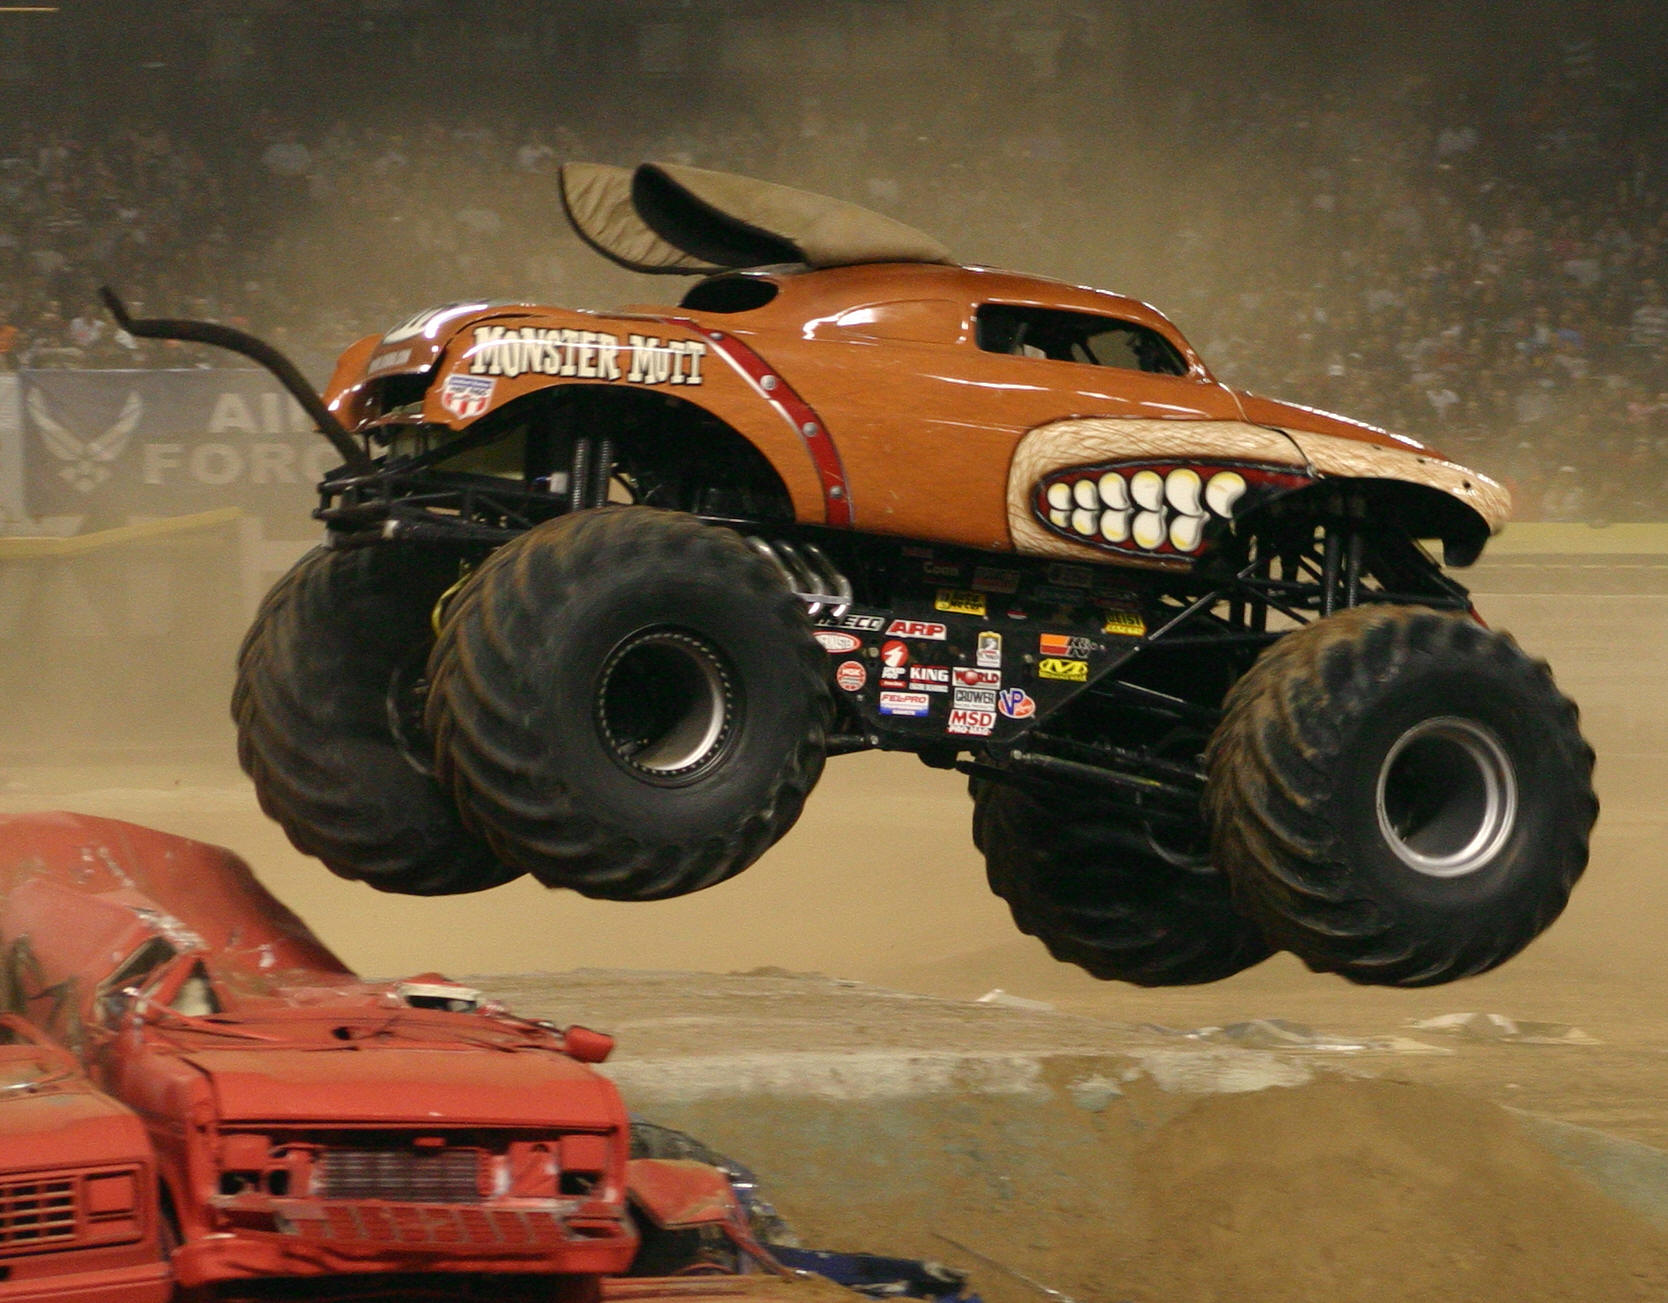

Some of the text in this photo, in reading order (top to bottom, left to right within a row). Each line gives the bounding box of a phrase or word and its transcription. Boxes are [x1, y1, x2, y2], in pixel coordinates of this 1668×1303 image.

[468, 325, 622, 381] MONSTER
[889, 622, 945, 637] ARP
[910, 668, 949, 682] KING
[1001, 690, 1024, 715] VP
[951, 711, 993, 727] MSD
